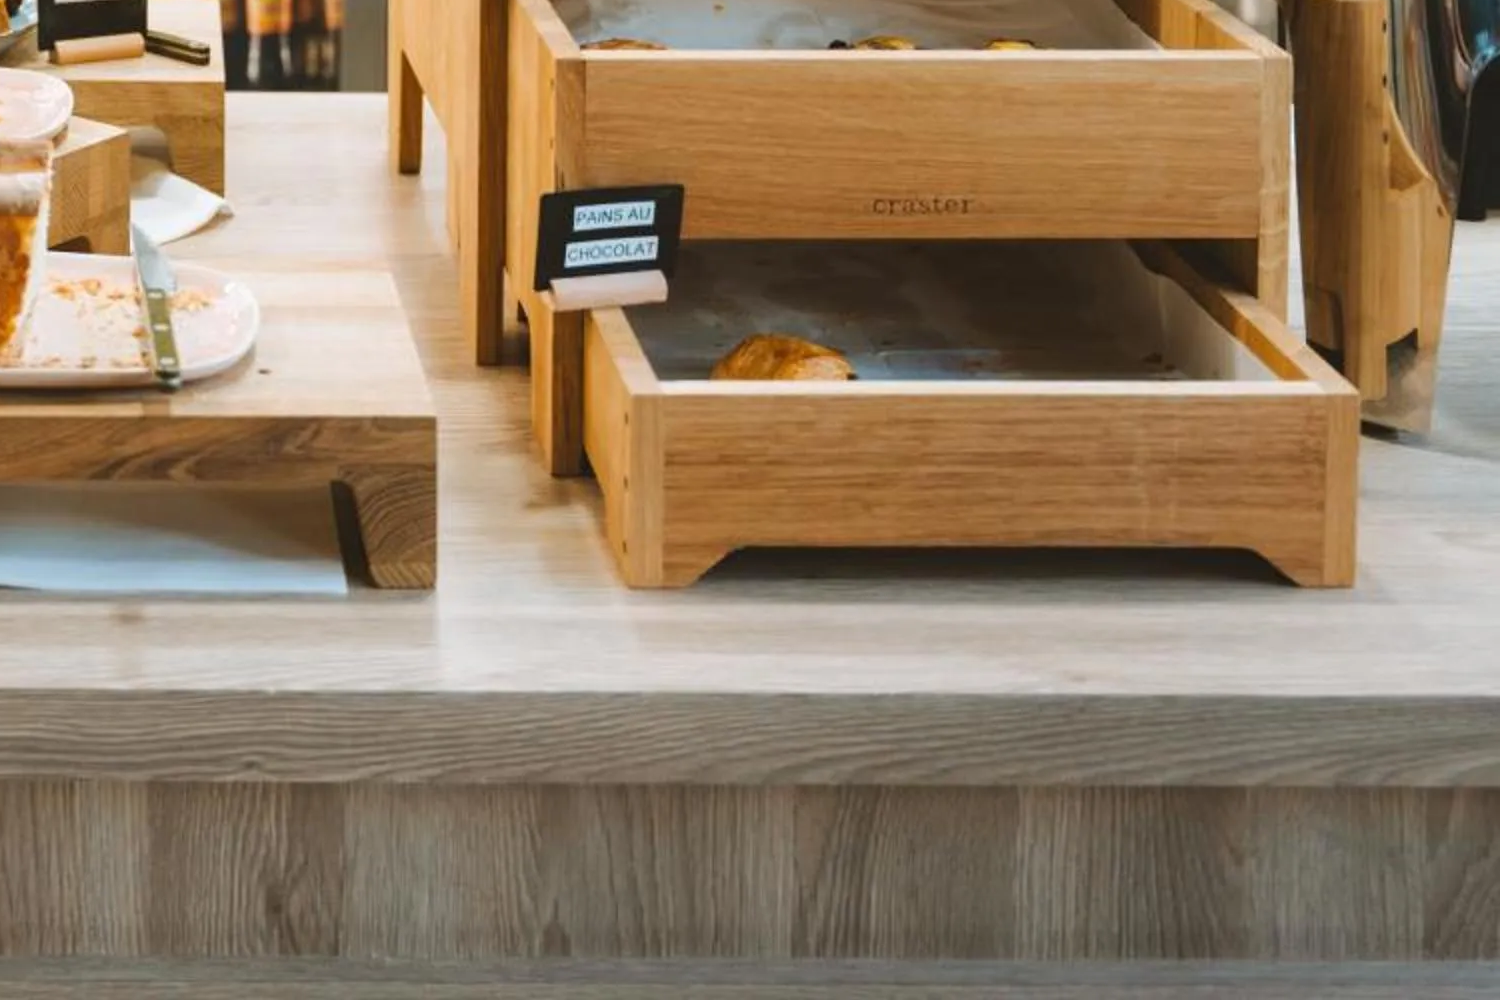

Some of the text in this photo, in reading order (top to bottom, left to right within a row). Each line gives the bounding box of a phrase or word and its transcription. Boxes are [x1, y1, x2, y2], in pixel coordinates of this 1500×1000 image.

[575, 206, 652, 226] PAINS AU
[872, 197, 975, 215] craster
[566, 241, 656, 262] CHOCOLAT
